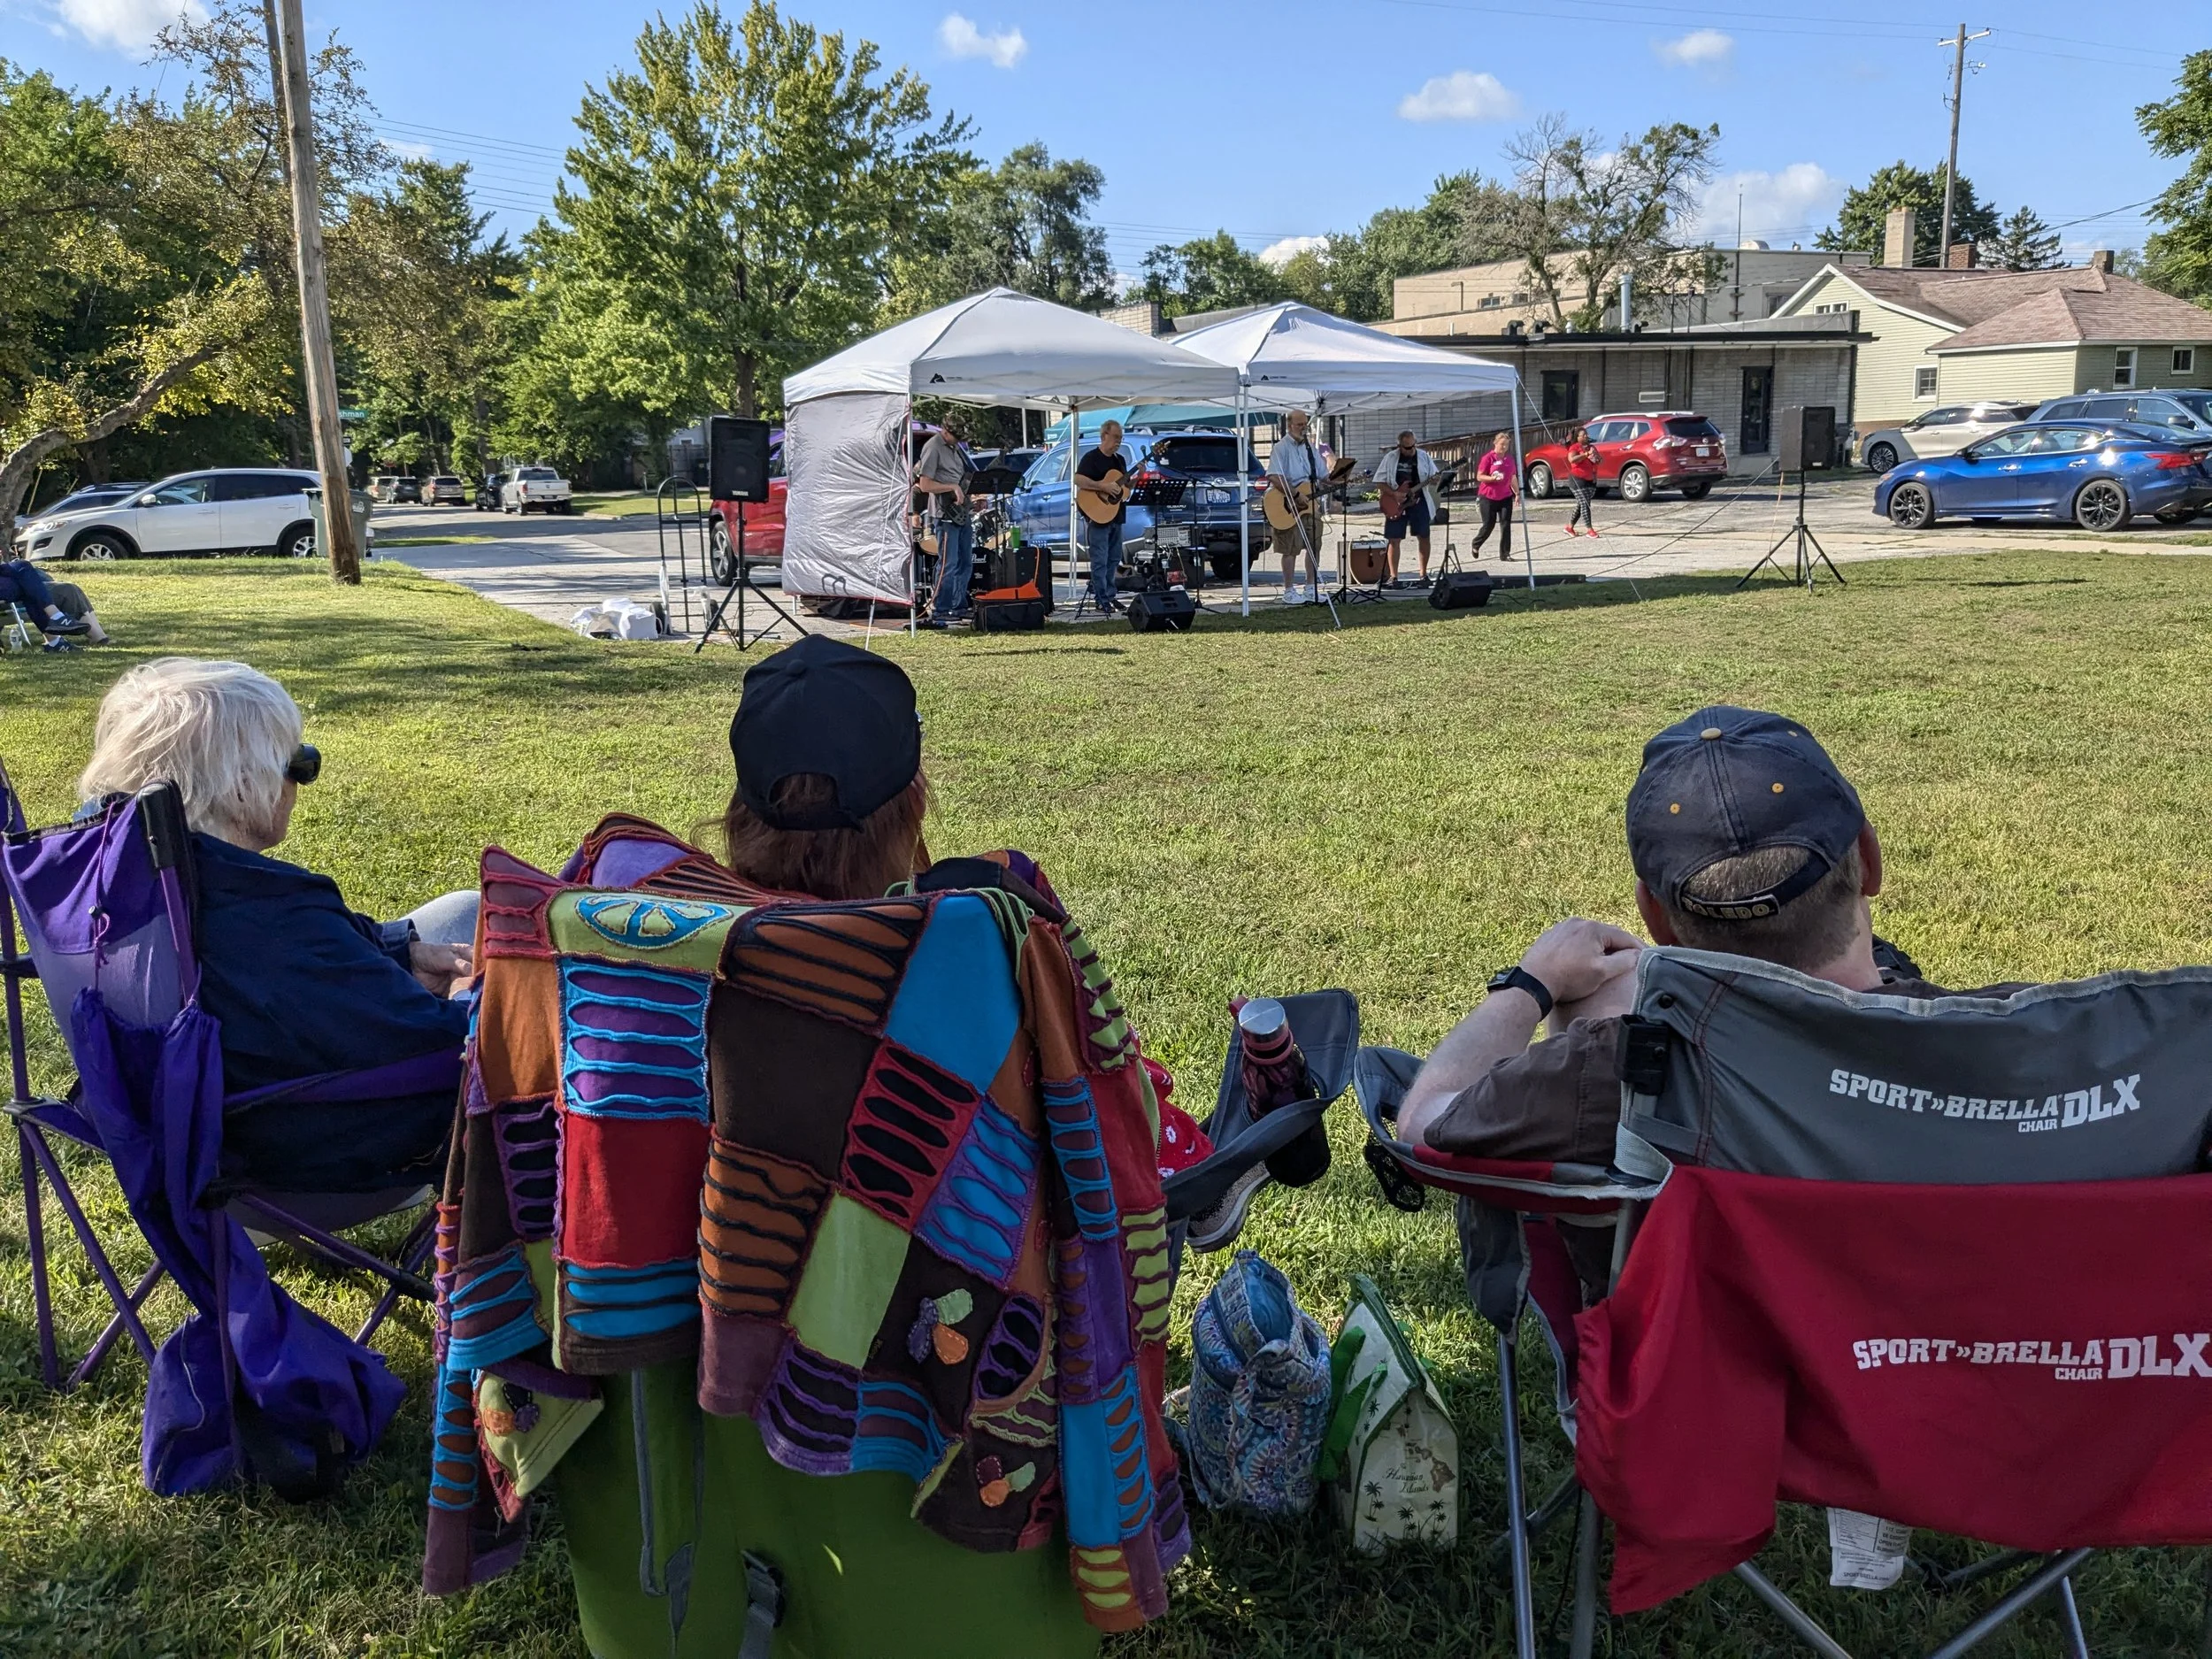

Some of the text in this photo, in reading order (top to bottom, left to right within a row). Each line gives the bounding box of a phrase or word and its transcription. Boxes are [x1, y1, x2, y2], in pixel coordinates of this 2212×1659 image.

[1681, 895, 1770, 919] TOLEDO
[2061, 1073, 2140, 1127] DLX
[2018, 1118, 2057, 1133] CHAIR
[2108, 1333, 2212, 1379] DLX
[2055, 1367, 2102, 1380] CHAIR
